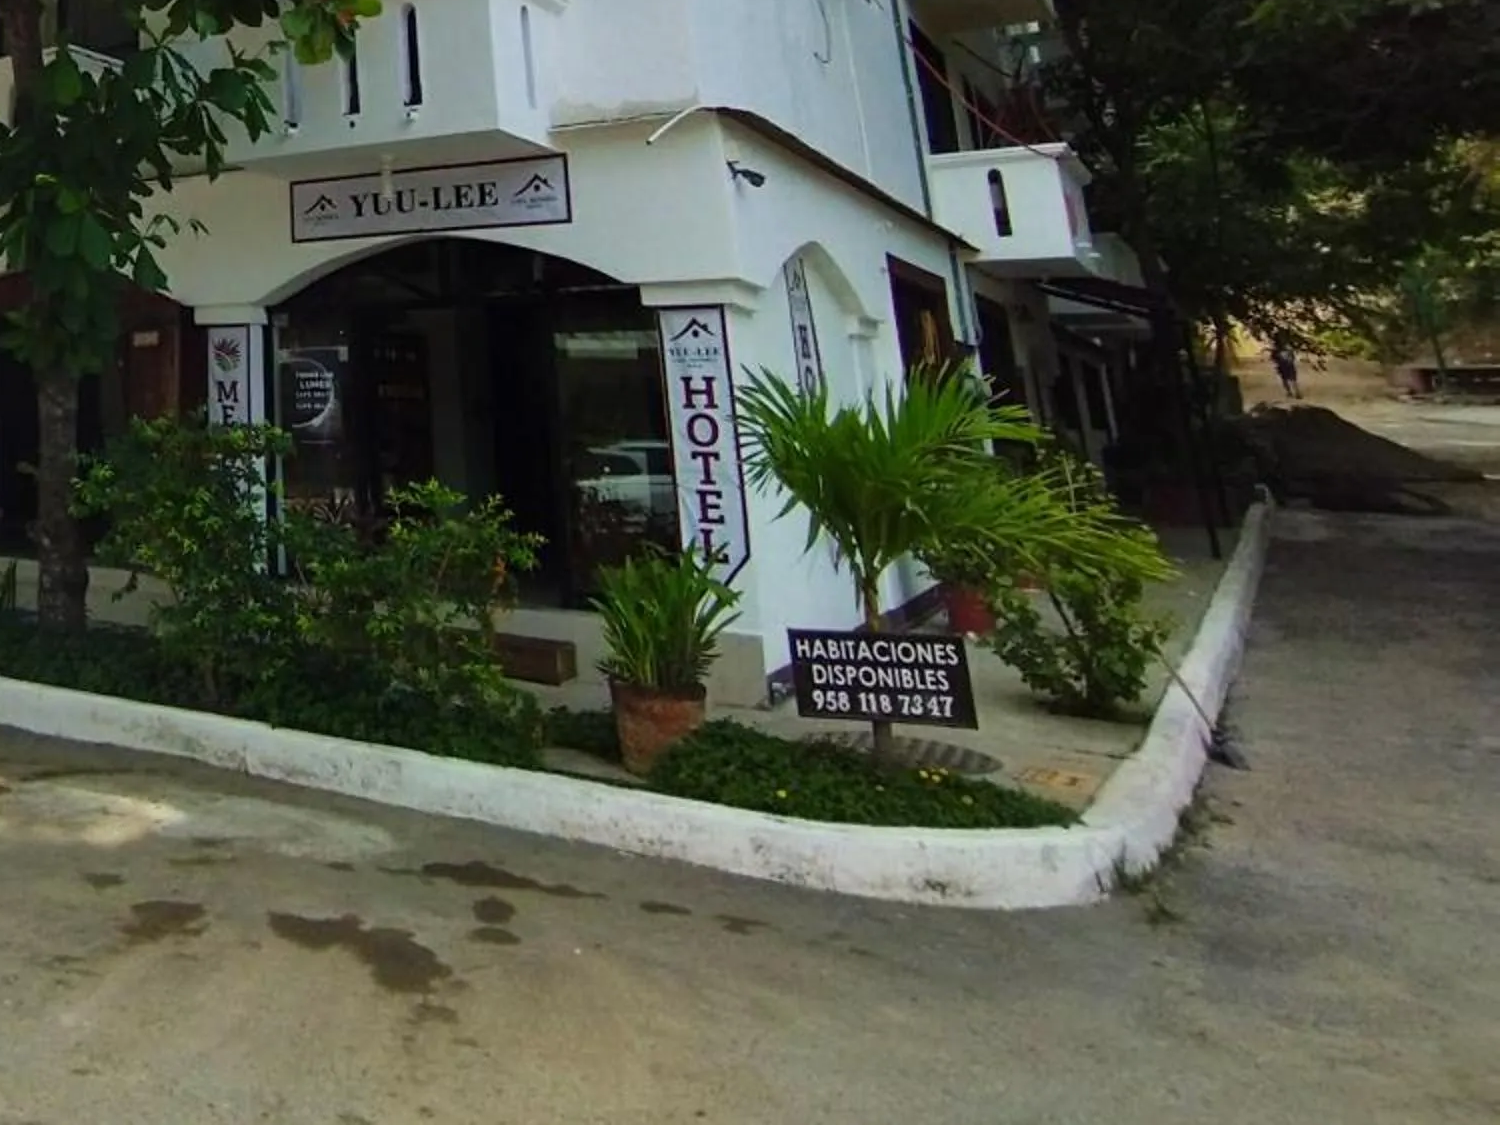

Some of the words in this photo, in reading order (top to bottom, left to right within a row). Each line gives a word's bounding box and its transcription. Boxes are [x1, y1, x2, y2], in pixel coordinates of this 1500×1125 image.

[349, 182, 499, 217] YUU-LEE
[680, 376, 729, 565] HOTEL
[796, 638, 959, 666] HABITACIONES
[812, 664, 950, 691] DISPONIBLES
[812, 690, 850, 712] 958
[858, 692, 893, 713] 118
